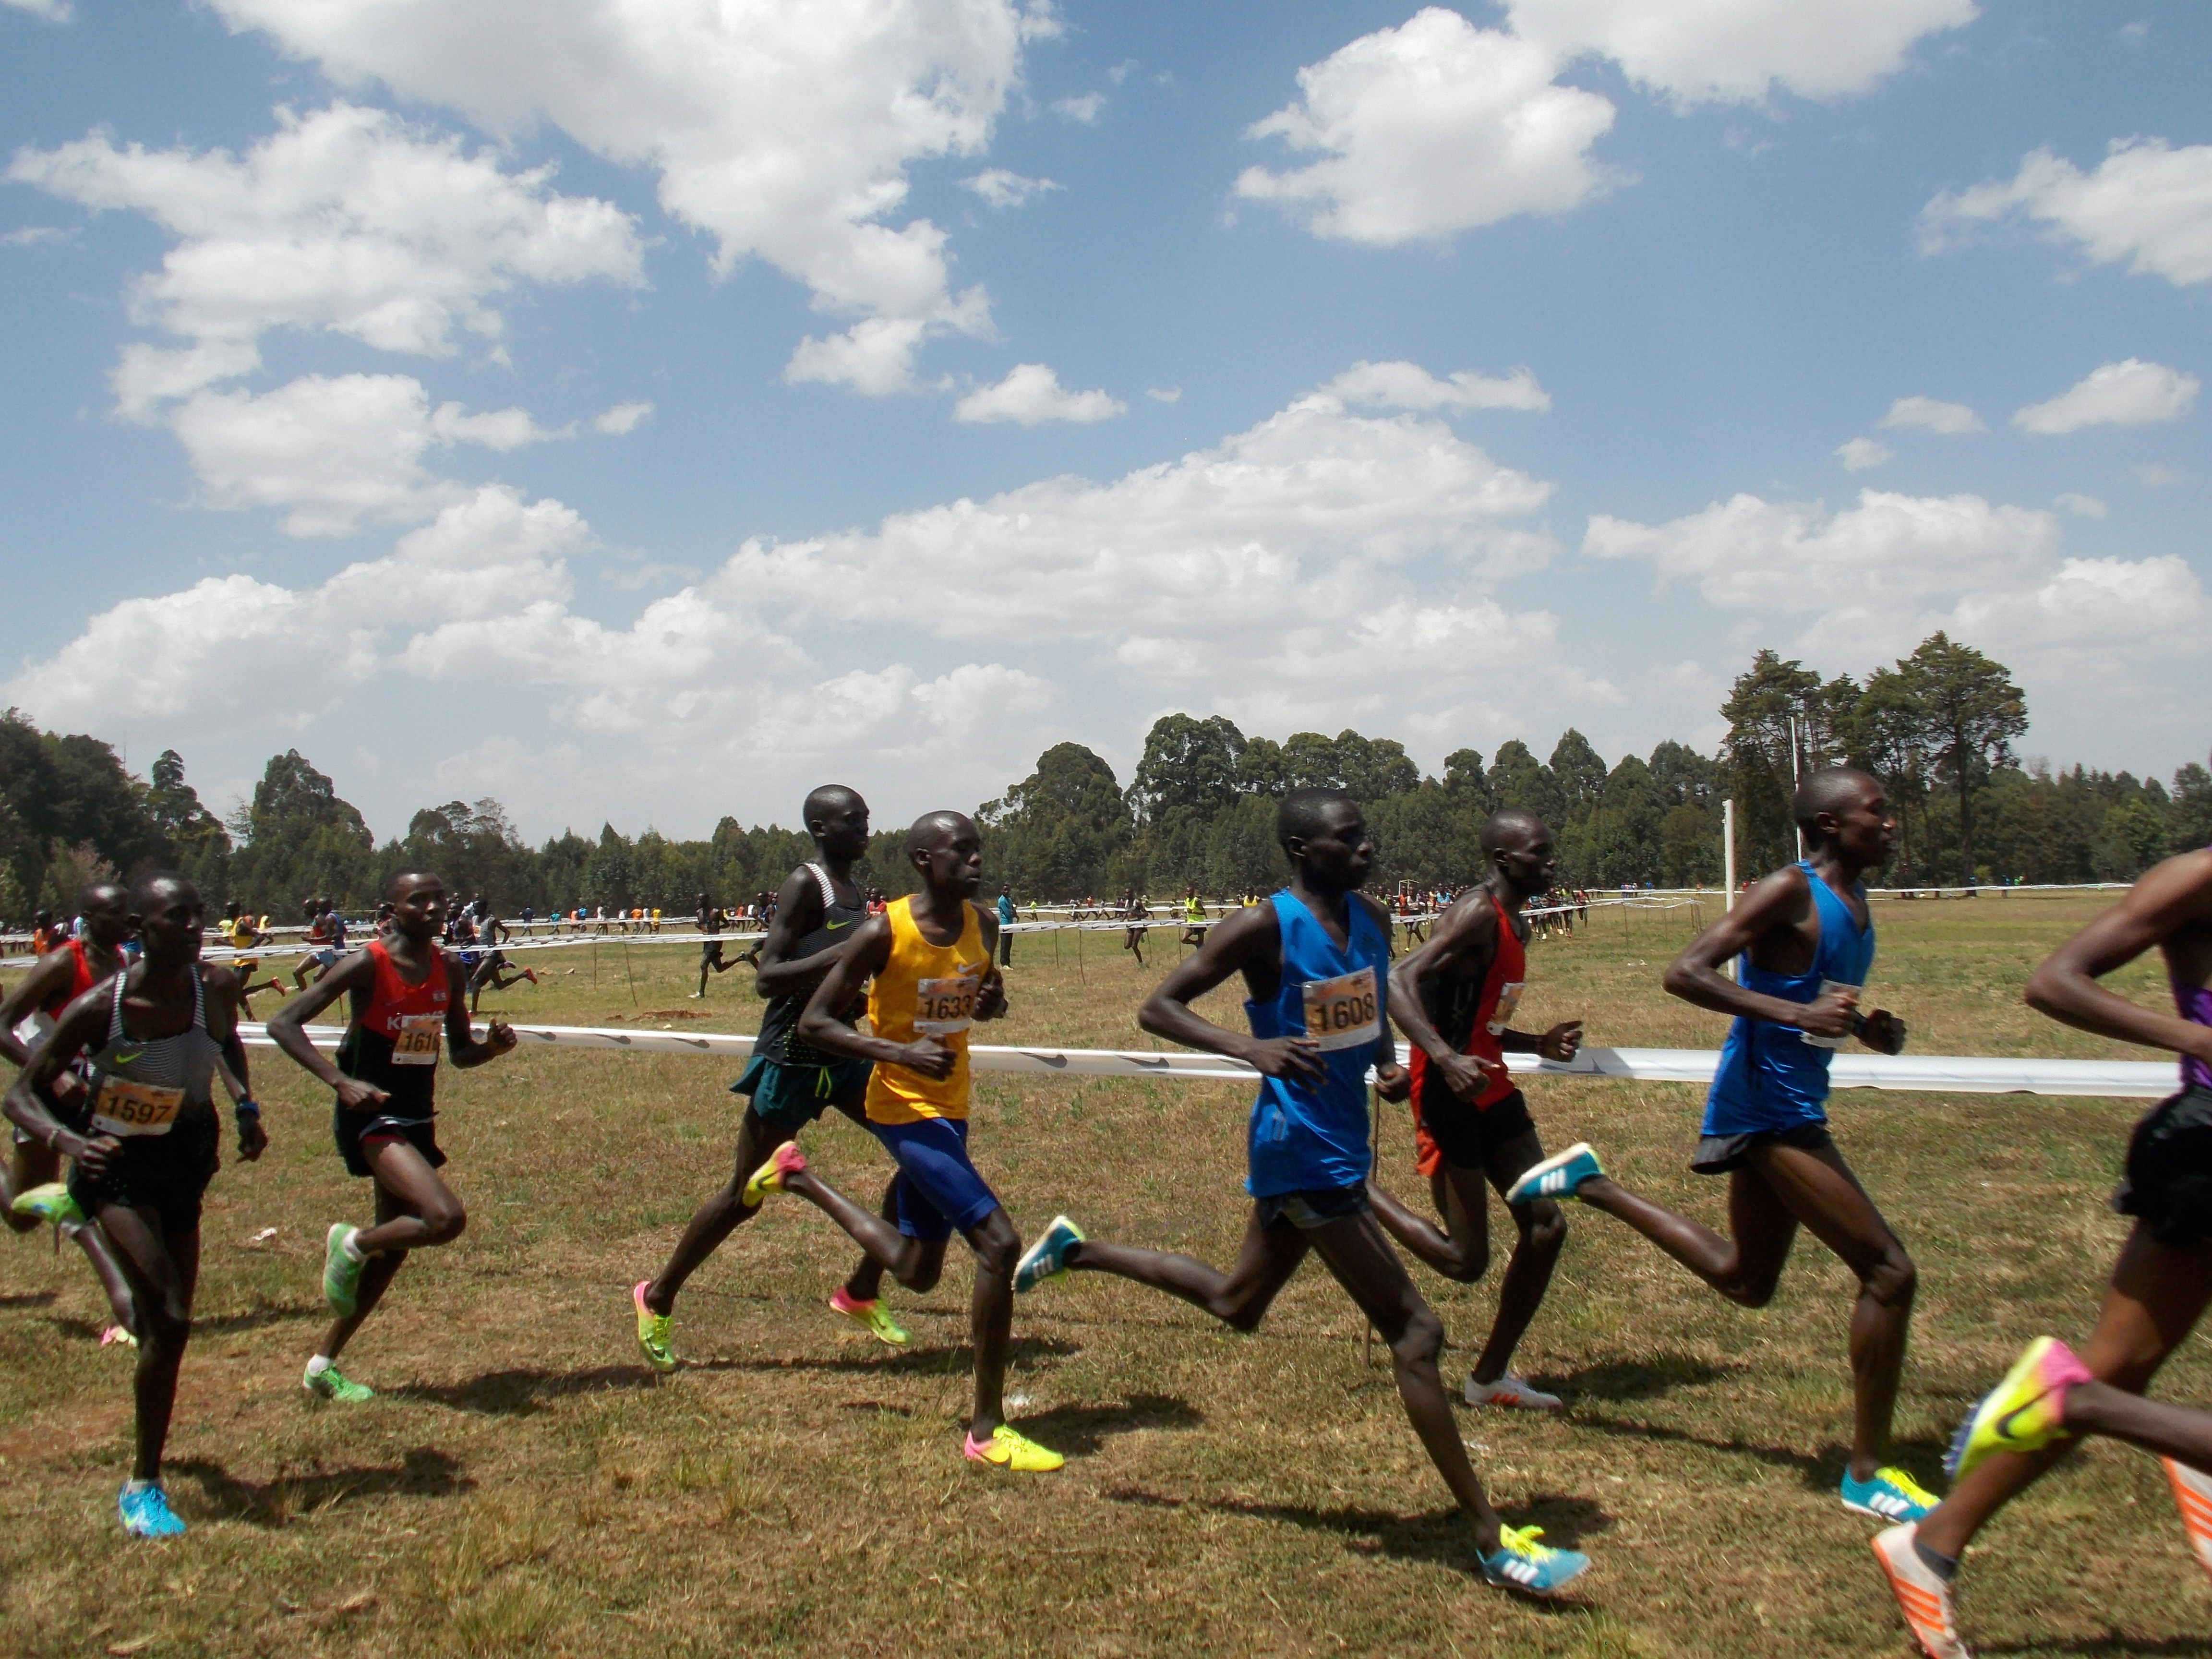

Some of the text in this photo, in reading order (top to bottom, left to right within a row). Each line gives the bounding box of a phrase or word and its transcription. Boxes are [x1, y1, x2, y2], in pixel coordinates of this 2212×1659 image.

[925, 994, 971, 1020] 1633
[1314, 992, 1374, 1032] 1608
[107, 1096, 171, 1125] 1597
